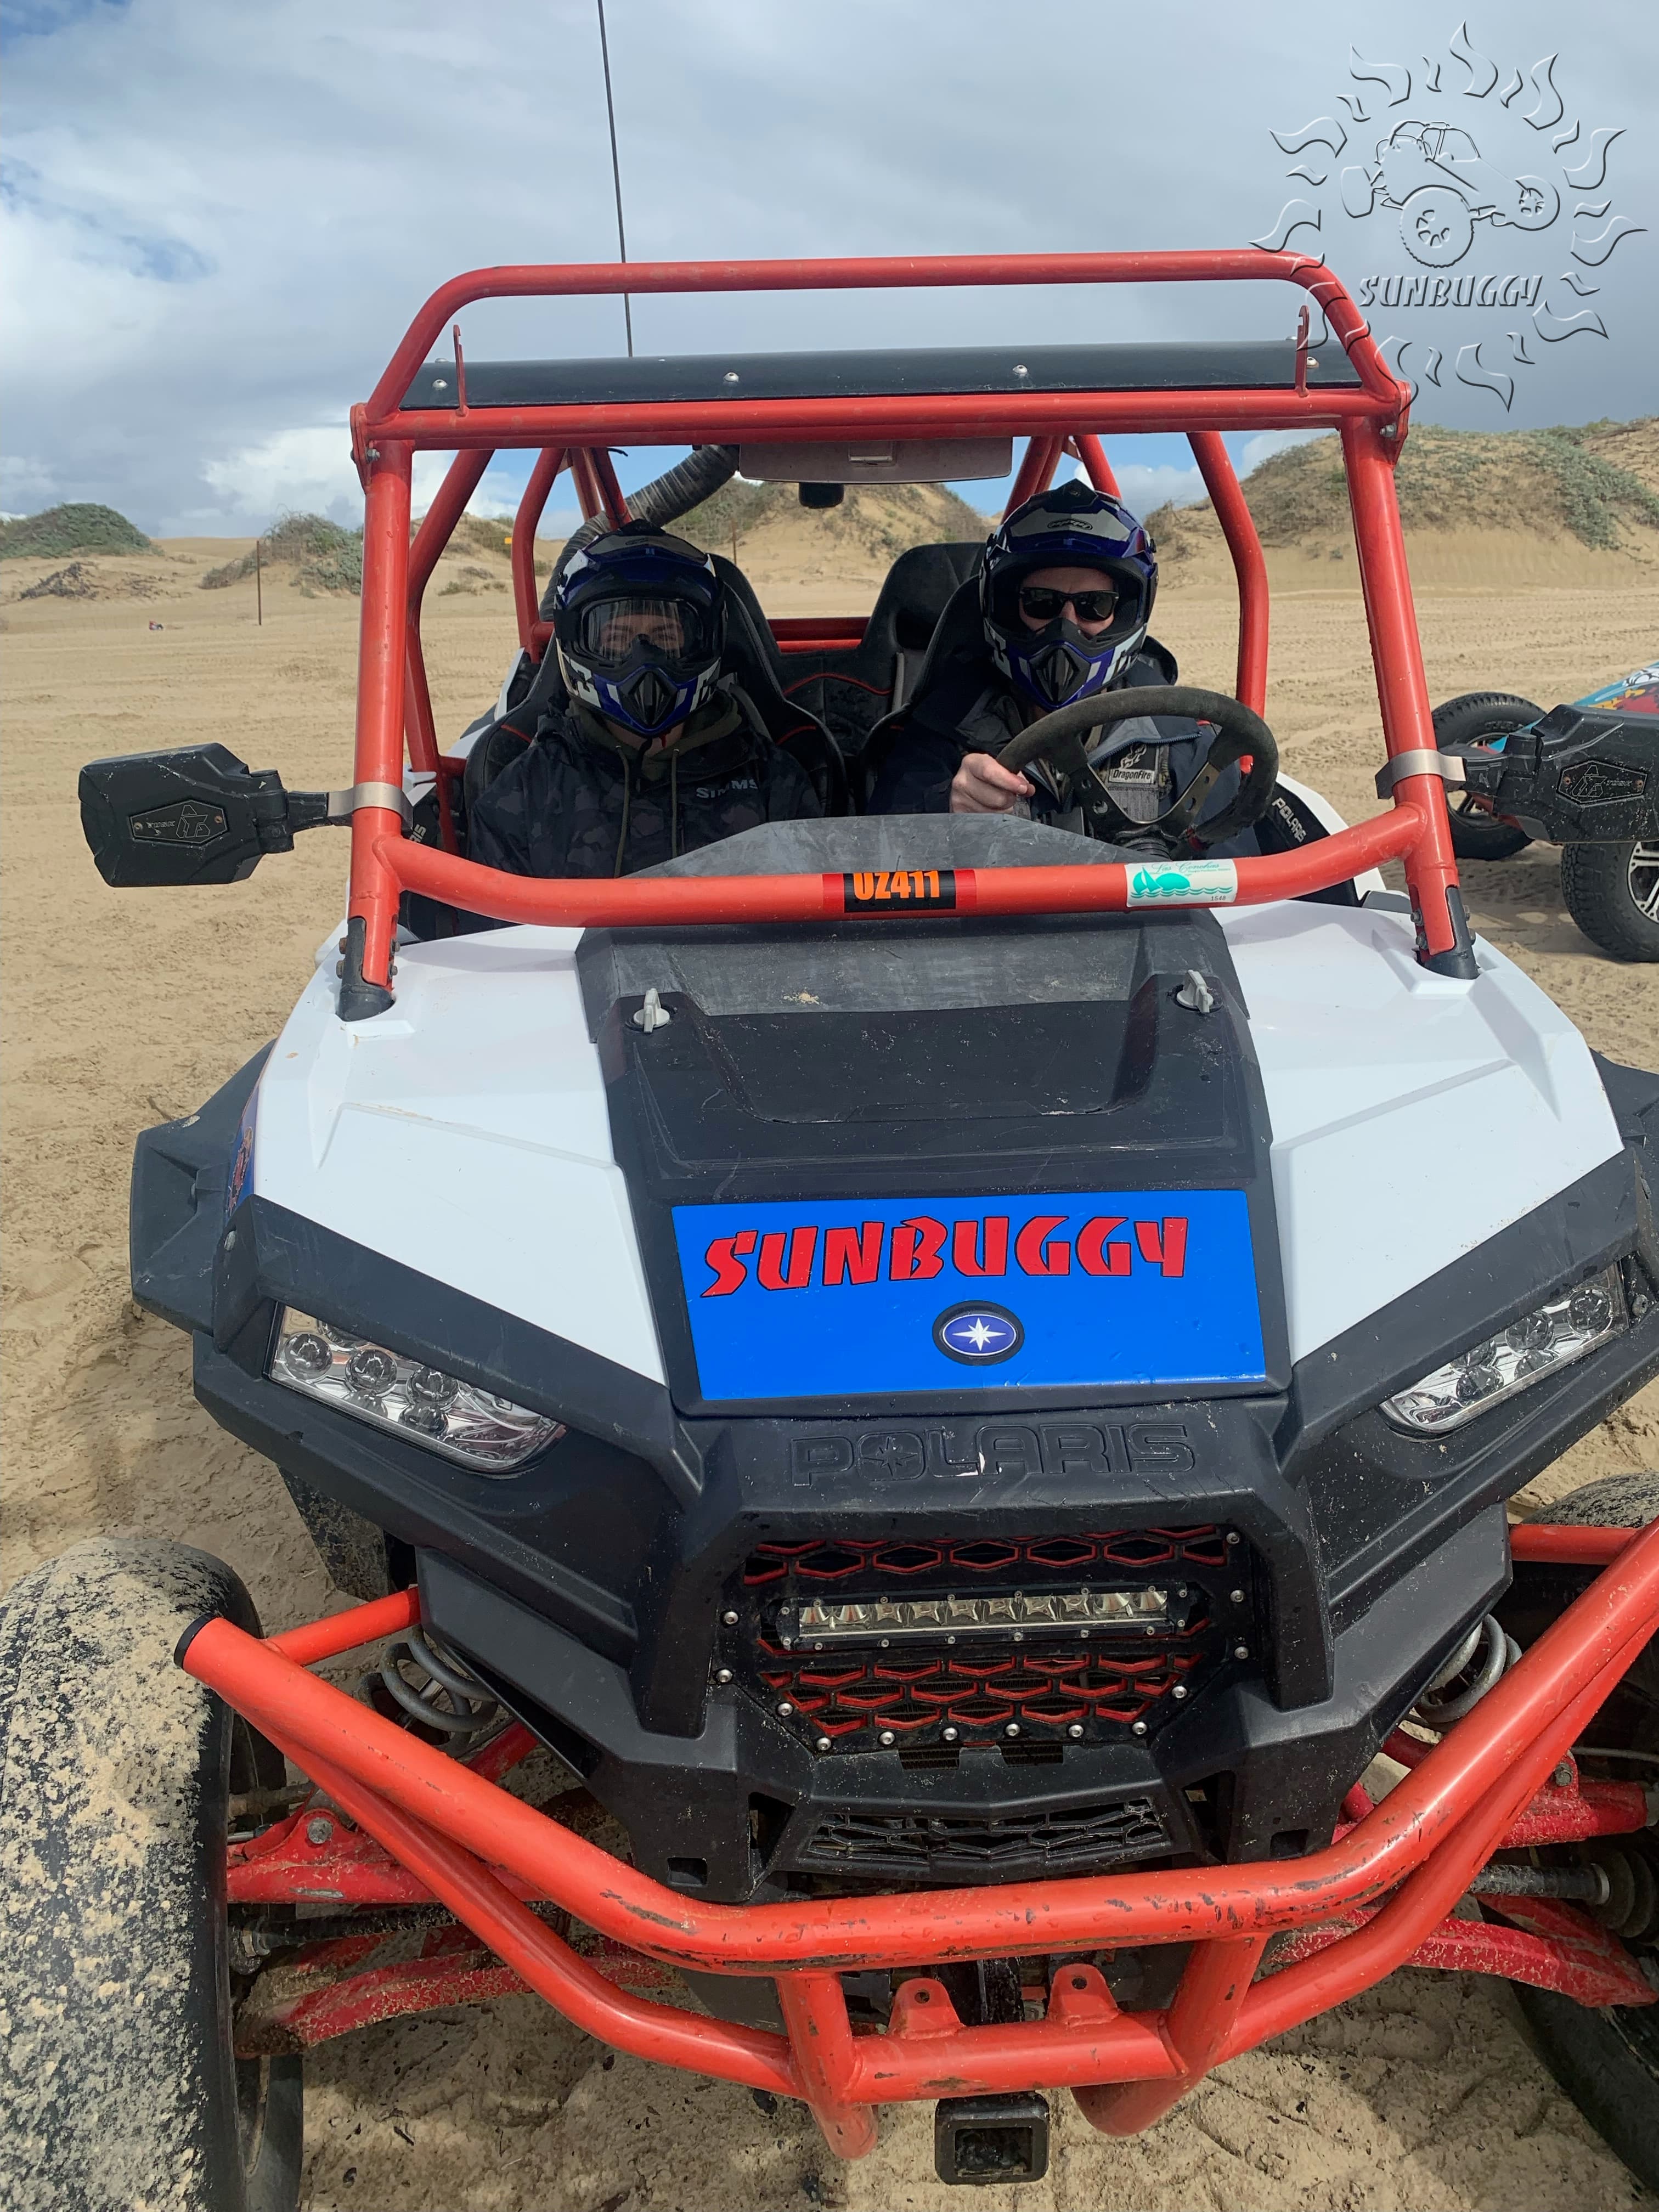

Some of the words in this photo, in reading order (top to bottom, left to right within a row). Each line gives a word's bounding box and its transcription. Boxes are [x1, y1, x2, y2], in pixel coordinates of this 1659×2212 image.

[1113, 770, 1151, 780] DragonFire
[700, 1216, 1188, 1297] SUNBUGGY
[790, 1423, 1195, 1487] POLARIS
